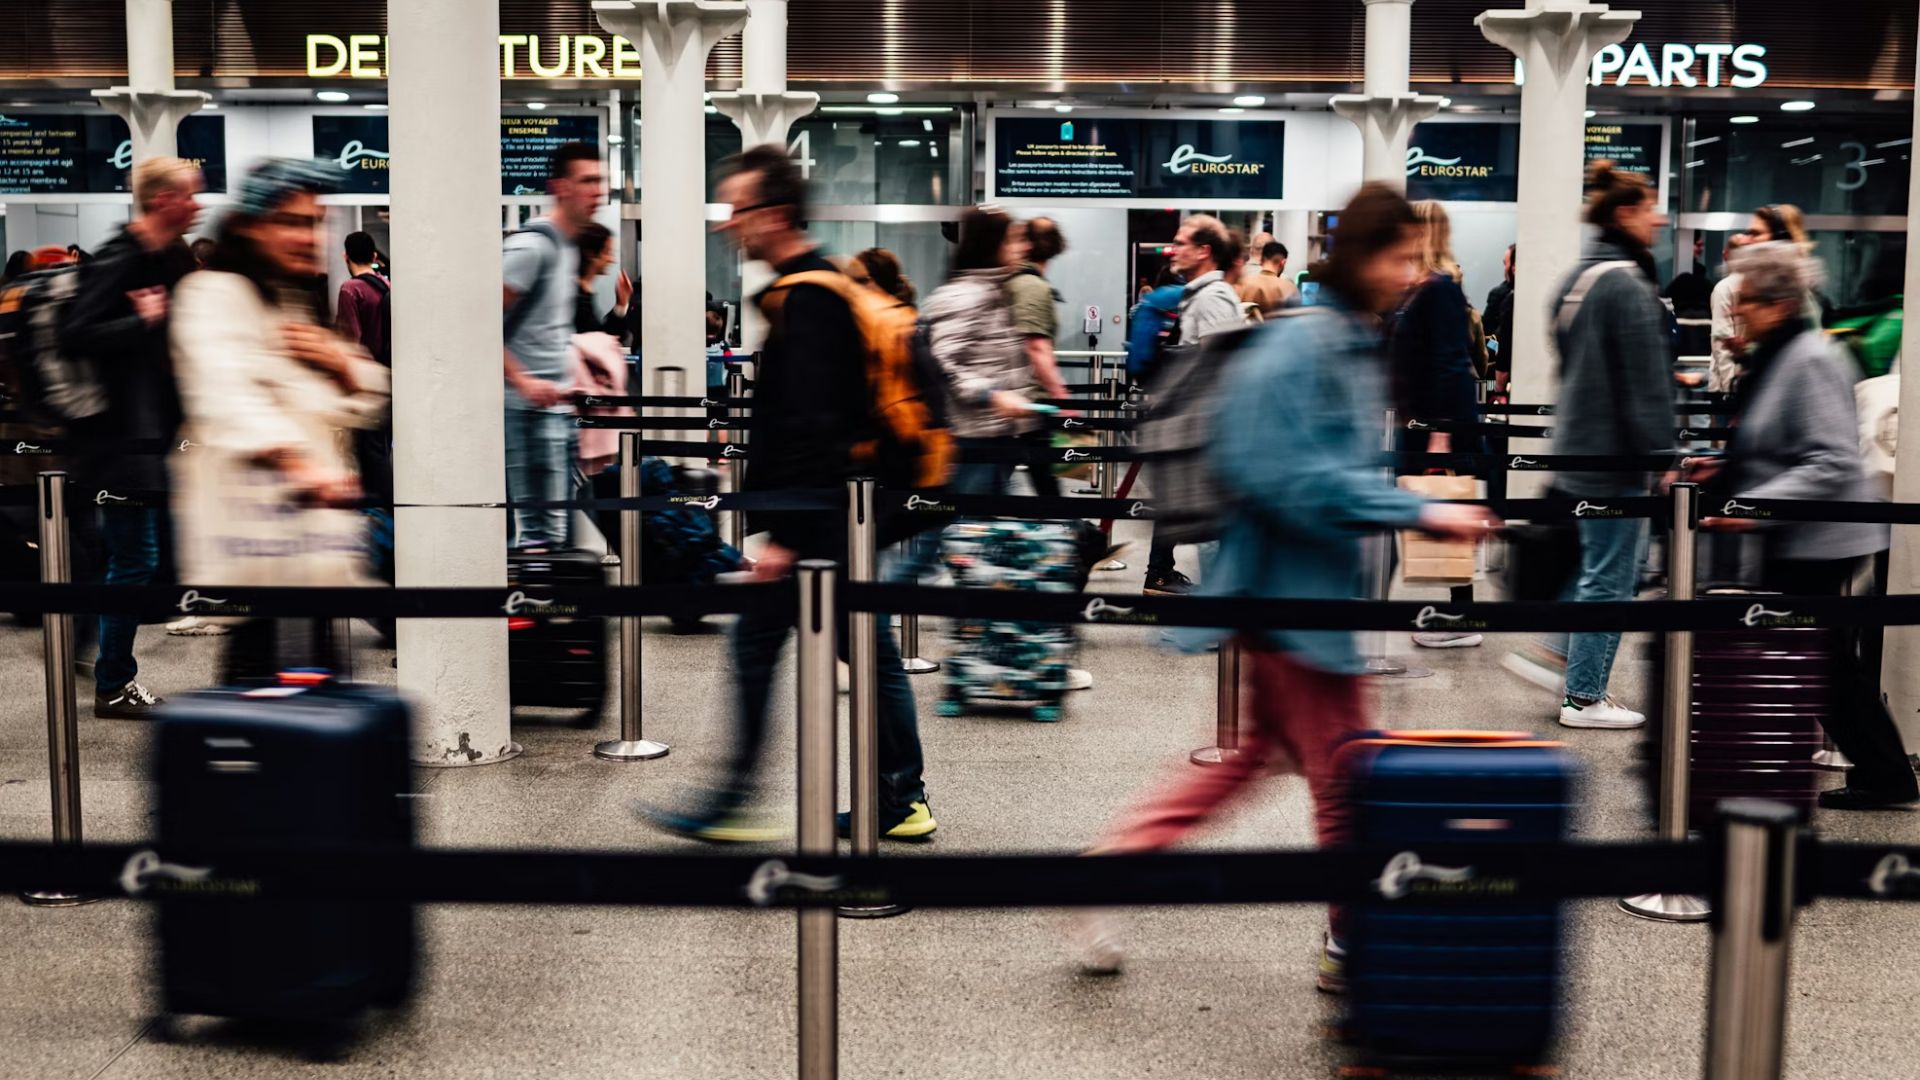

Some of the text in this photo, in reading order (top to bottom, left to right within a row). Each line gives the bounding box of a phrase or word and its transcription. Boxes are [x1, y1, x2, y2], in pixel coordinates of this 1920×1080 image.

[306, 34, 643, 78] DETURE
[1514, 43, 1767, 88] PARTS
[1584, 135, 1610, 143] EMBLE
[1586, 126, 1622, 134] VOYAGER
[786, 130, 816, 180] 4
[1836, 142, 1868, 190] 3
